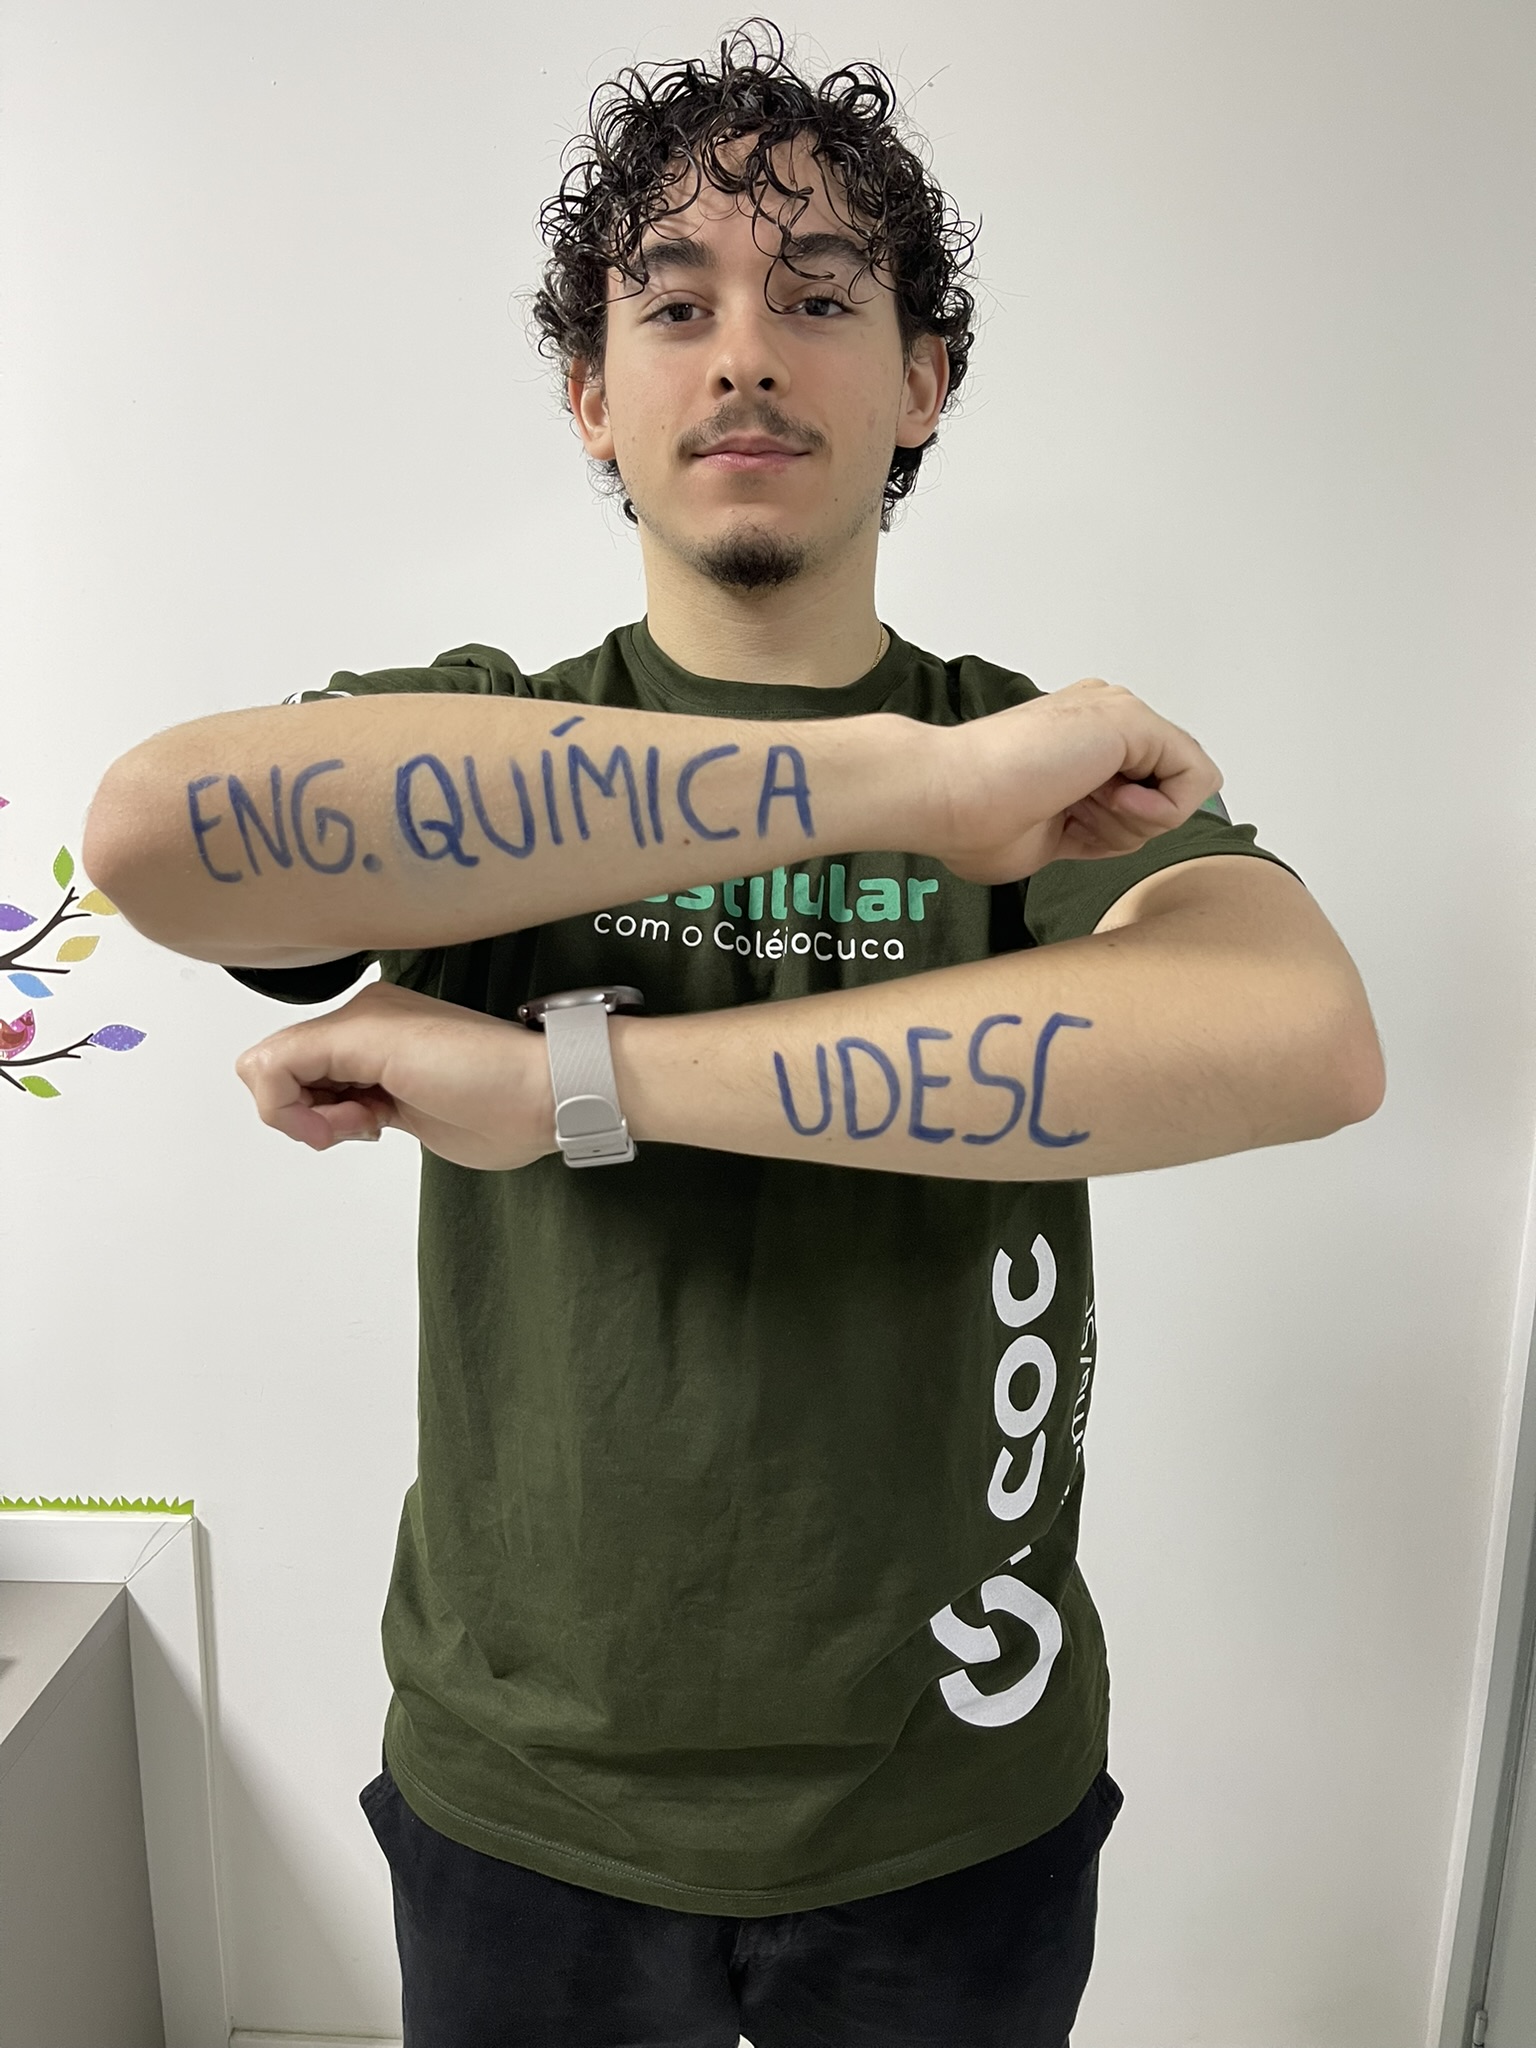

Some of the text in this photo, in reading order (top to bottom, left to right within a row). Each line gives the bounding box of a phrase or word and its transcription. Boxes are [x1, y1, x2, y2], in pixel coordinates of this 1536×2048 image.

[187, 715, 816, 883] ENG. QUÍMICA
[594, 912, 670, 941] com
[681, 925, 703, 947] o
[773, 1012, 1093, 1148] UDESC
